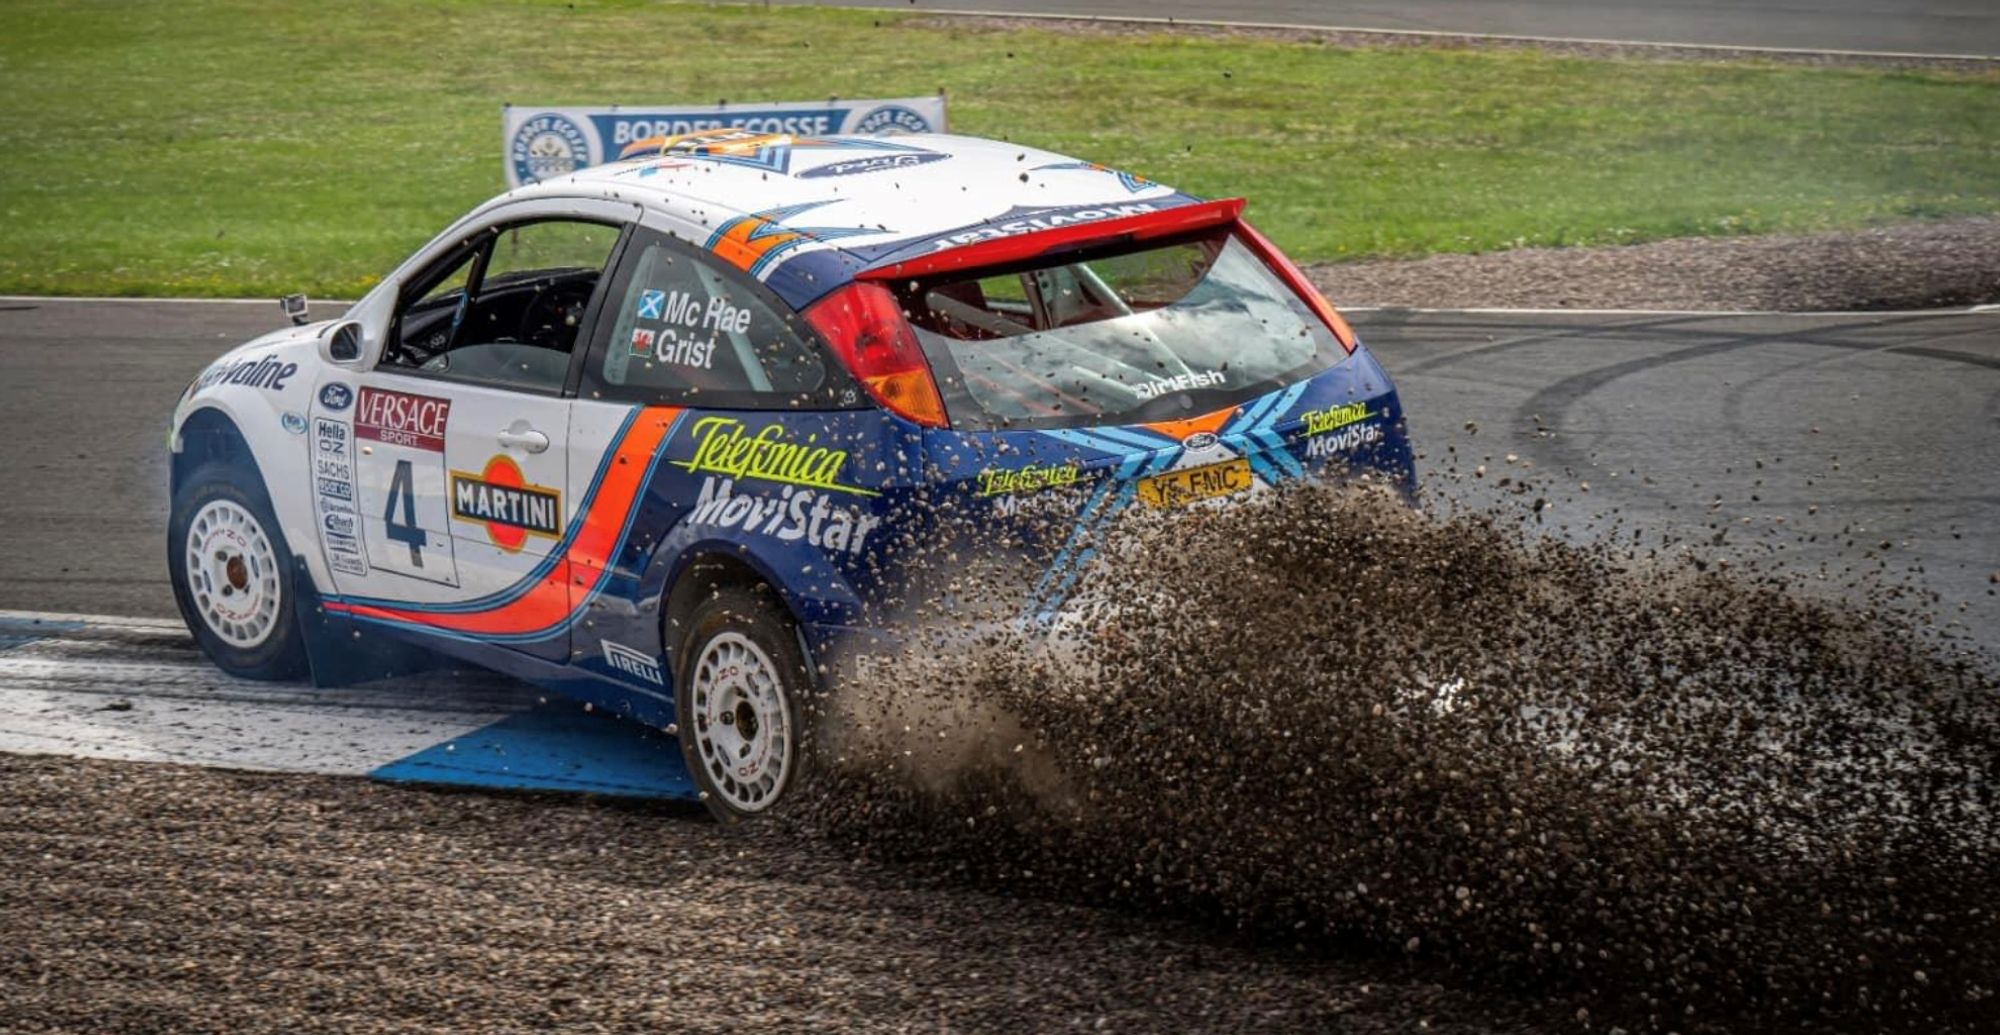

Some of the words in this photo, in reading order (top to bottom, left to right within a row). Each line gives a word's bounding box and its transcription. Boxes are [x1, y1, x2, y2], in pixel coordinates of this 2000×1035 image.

[663, 291, 701, 327] Mc
[703, 296, 750, 335] Rae
[656, 329, 717, 370] Grist
[324, 384, 348, 407] Ford
[360, 390, 448, 437] VERSACE
[318, 421, 346, 441] Hella
[319, 438, 344, 454] OZ
[380, 430, 418, 446] SPORT
[317, 460, 350, 480] SACHS
[385, 460, 427, 569] 4
[456, 480, 555, 530] MARTINI
[687, 476, 881, 553] MoviStar
[601, 638, 664, 686] PIRELLI
